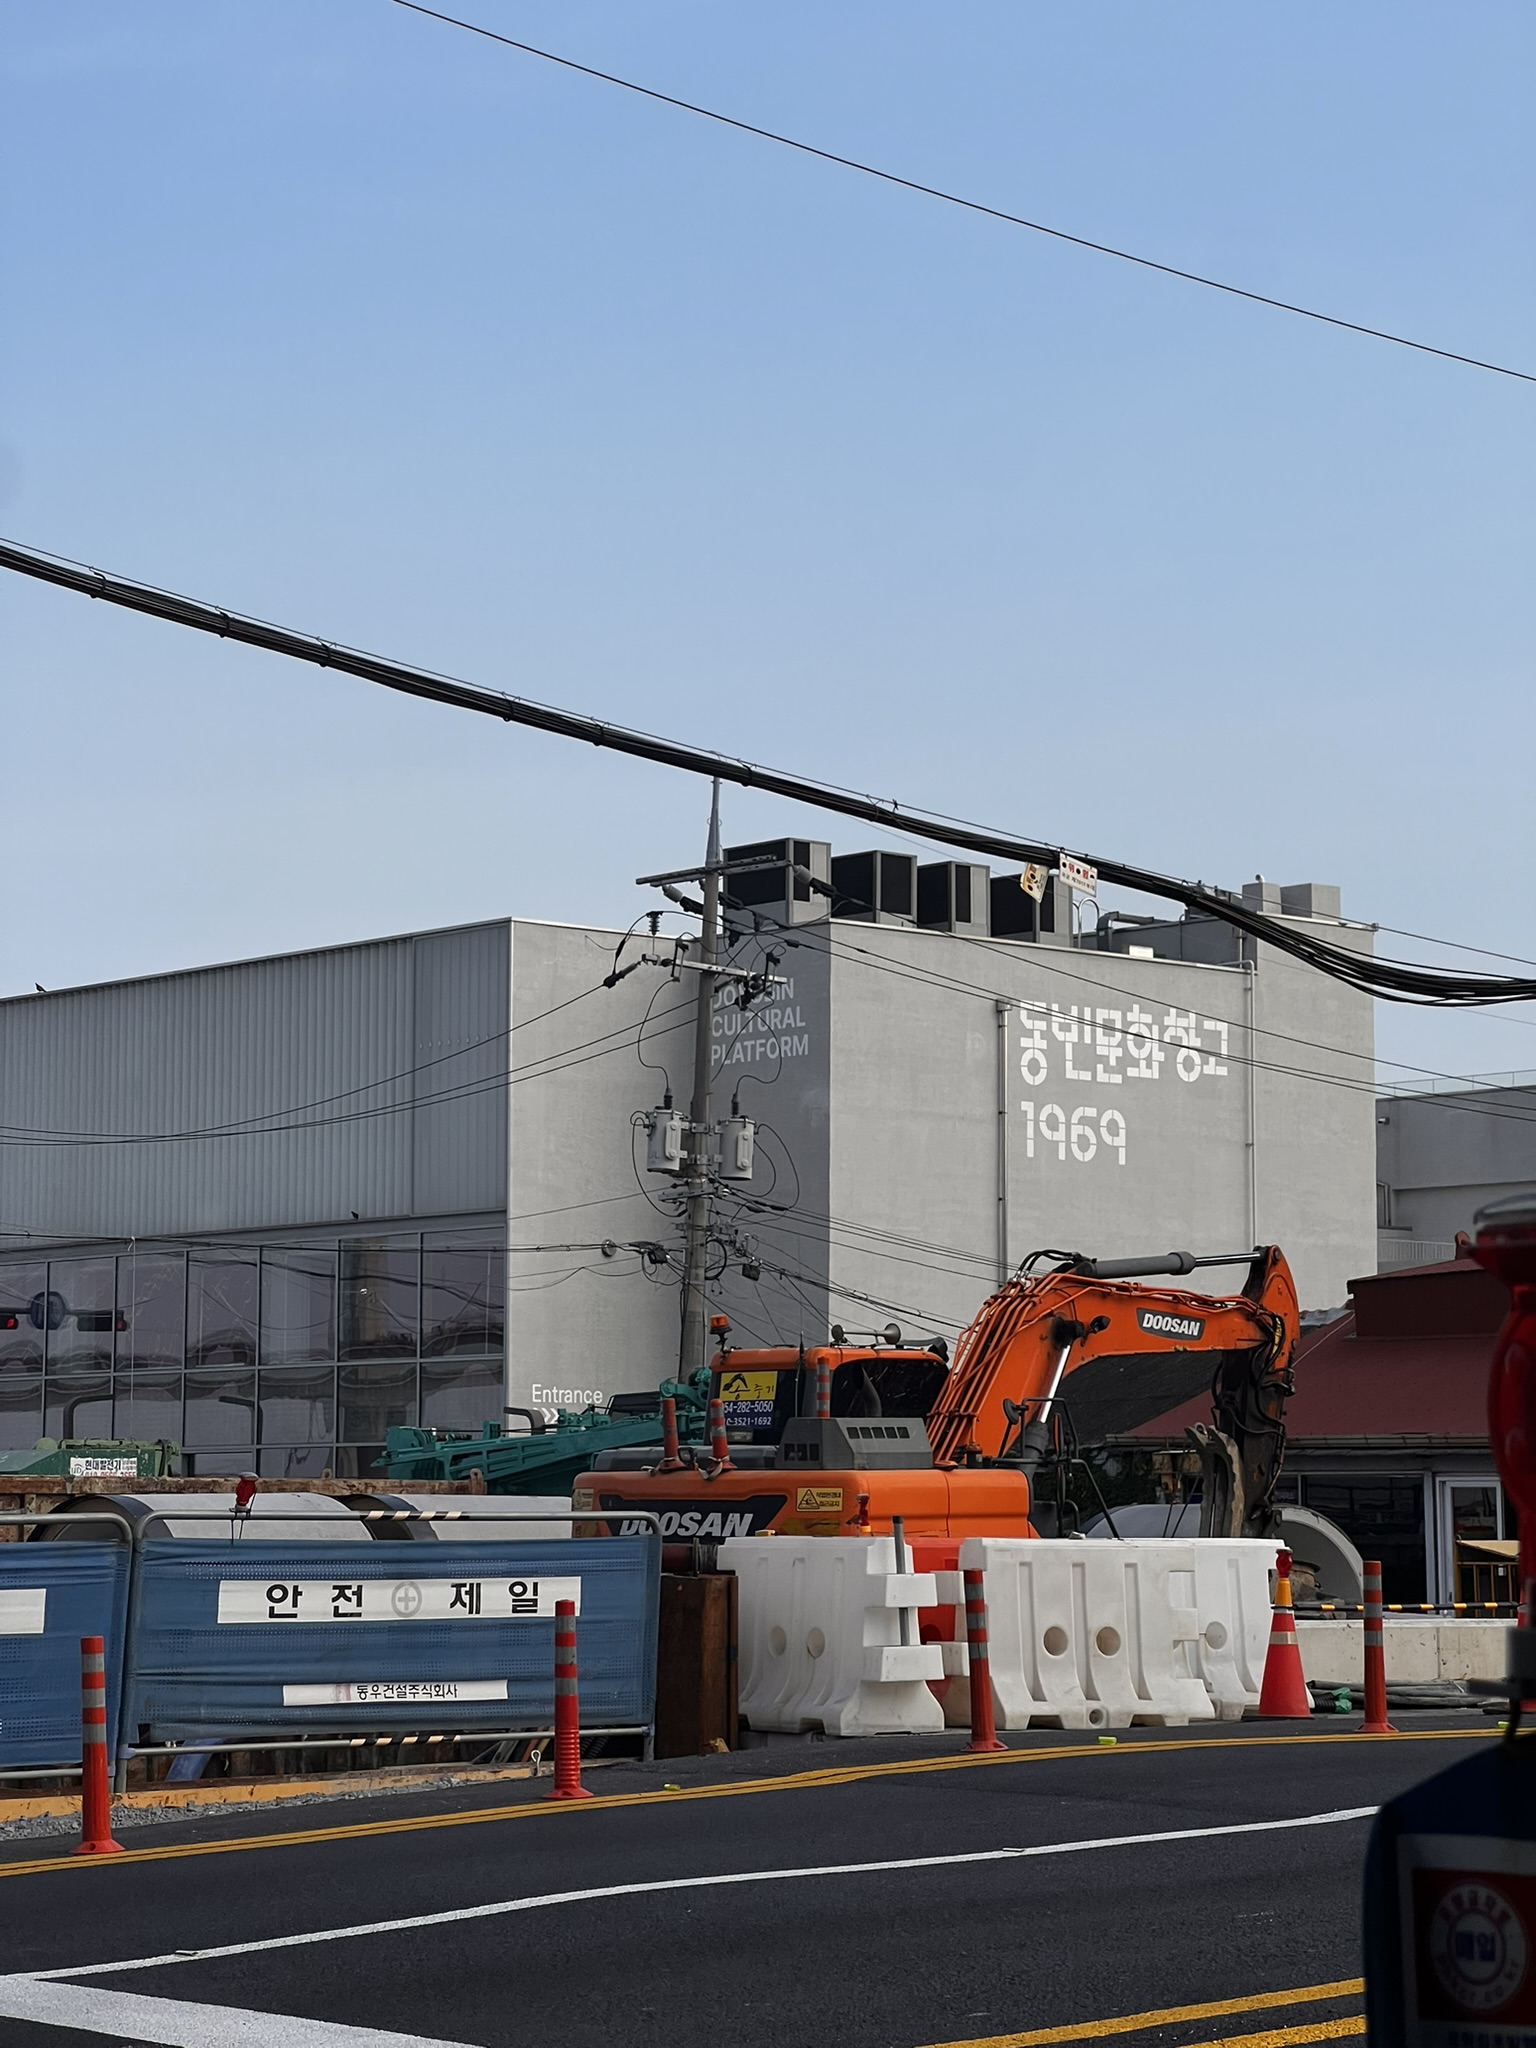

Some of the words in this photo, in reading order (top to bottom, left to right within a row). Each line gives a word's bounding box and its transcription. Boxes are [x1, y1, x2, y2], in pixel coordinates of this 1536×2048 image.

[712, 1006, 806, 1037] CULTURAL
[711, 1034, 809, 1066] PLATFORM
[1020, 1000, 1228, 1085] 동빈문화창고
[1021, 1101, 1126, 1165] 1969
[1142, 1313, 1200, 1336] DOOSAN
[532, 1384, 603, 1404] Entrance
[723, 1401, 774, 1414] 54-282-5050
[356, 1684, 459, 1700] 동우건설주식회사
